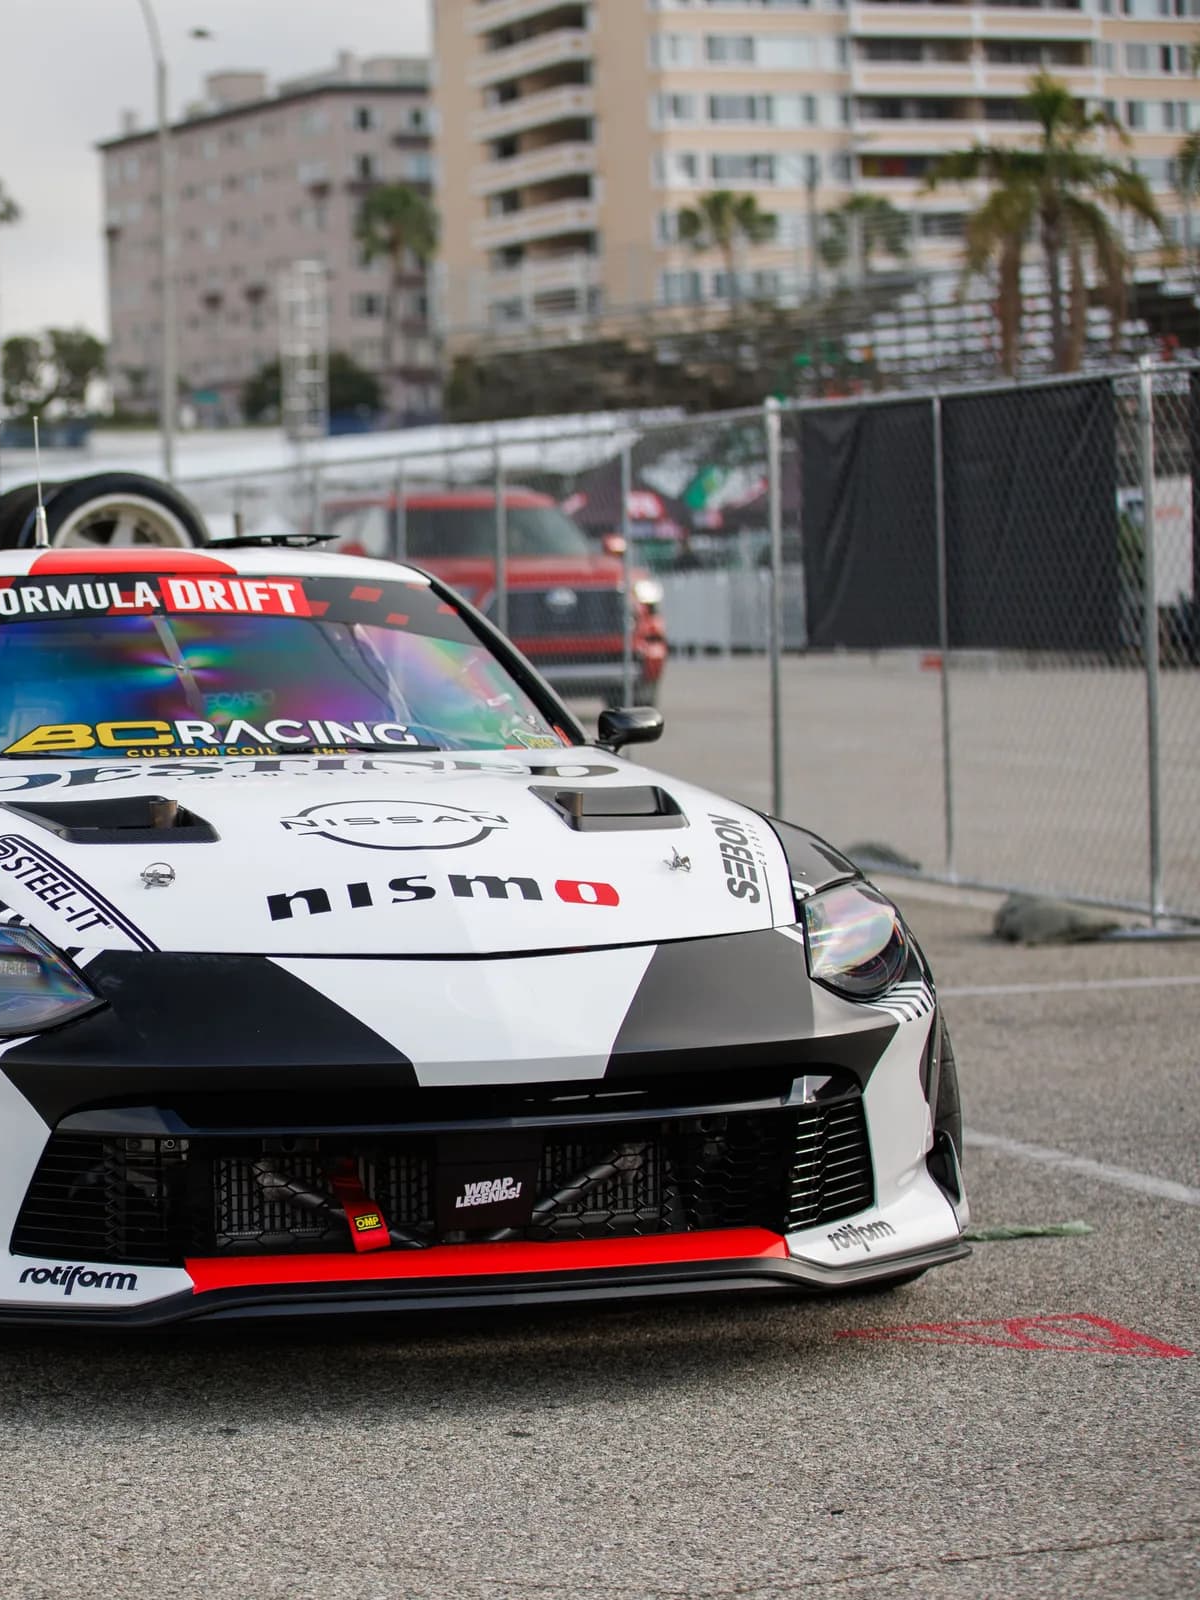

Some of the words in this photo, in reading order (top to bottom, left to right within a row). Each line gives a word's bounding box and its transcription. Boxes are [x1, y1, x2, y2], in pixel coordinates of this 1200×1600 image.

[168, 579, 296, 613] DRIFT
[127, 747, 219, 758] CUSTOM
[278, 813, 509, 831] NISSAN
[707, 813, 761, 904] SEBON
[0, 856, 110, 933] STEEL-IT
[464, 1176, 514, 1195] WRAP
[356, 1216, 379, 1228] OMP
[827, 1220, 896, 1252] rotiform
[19, 1266, 138, 1295] rotiform
